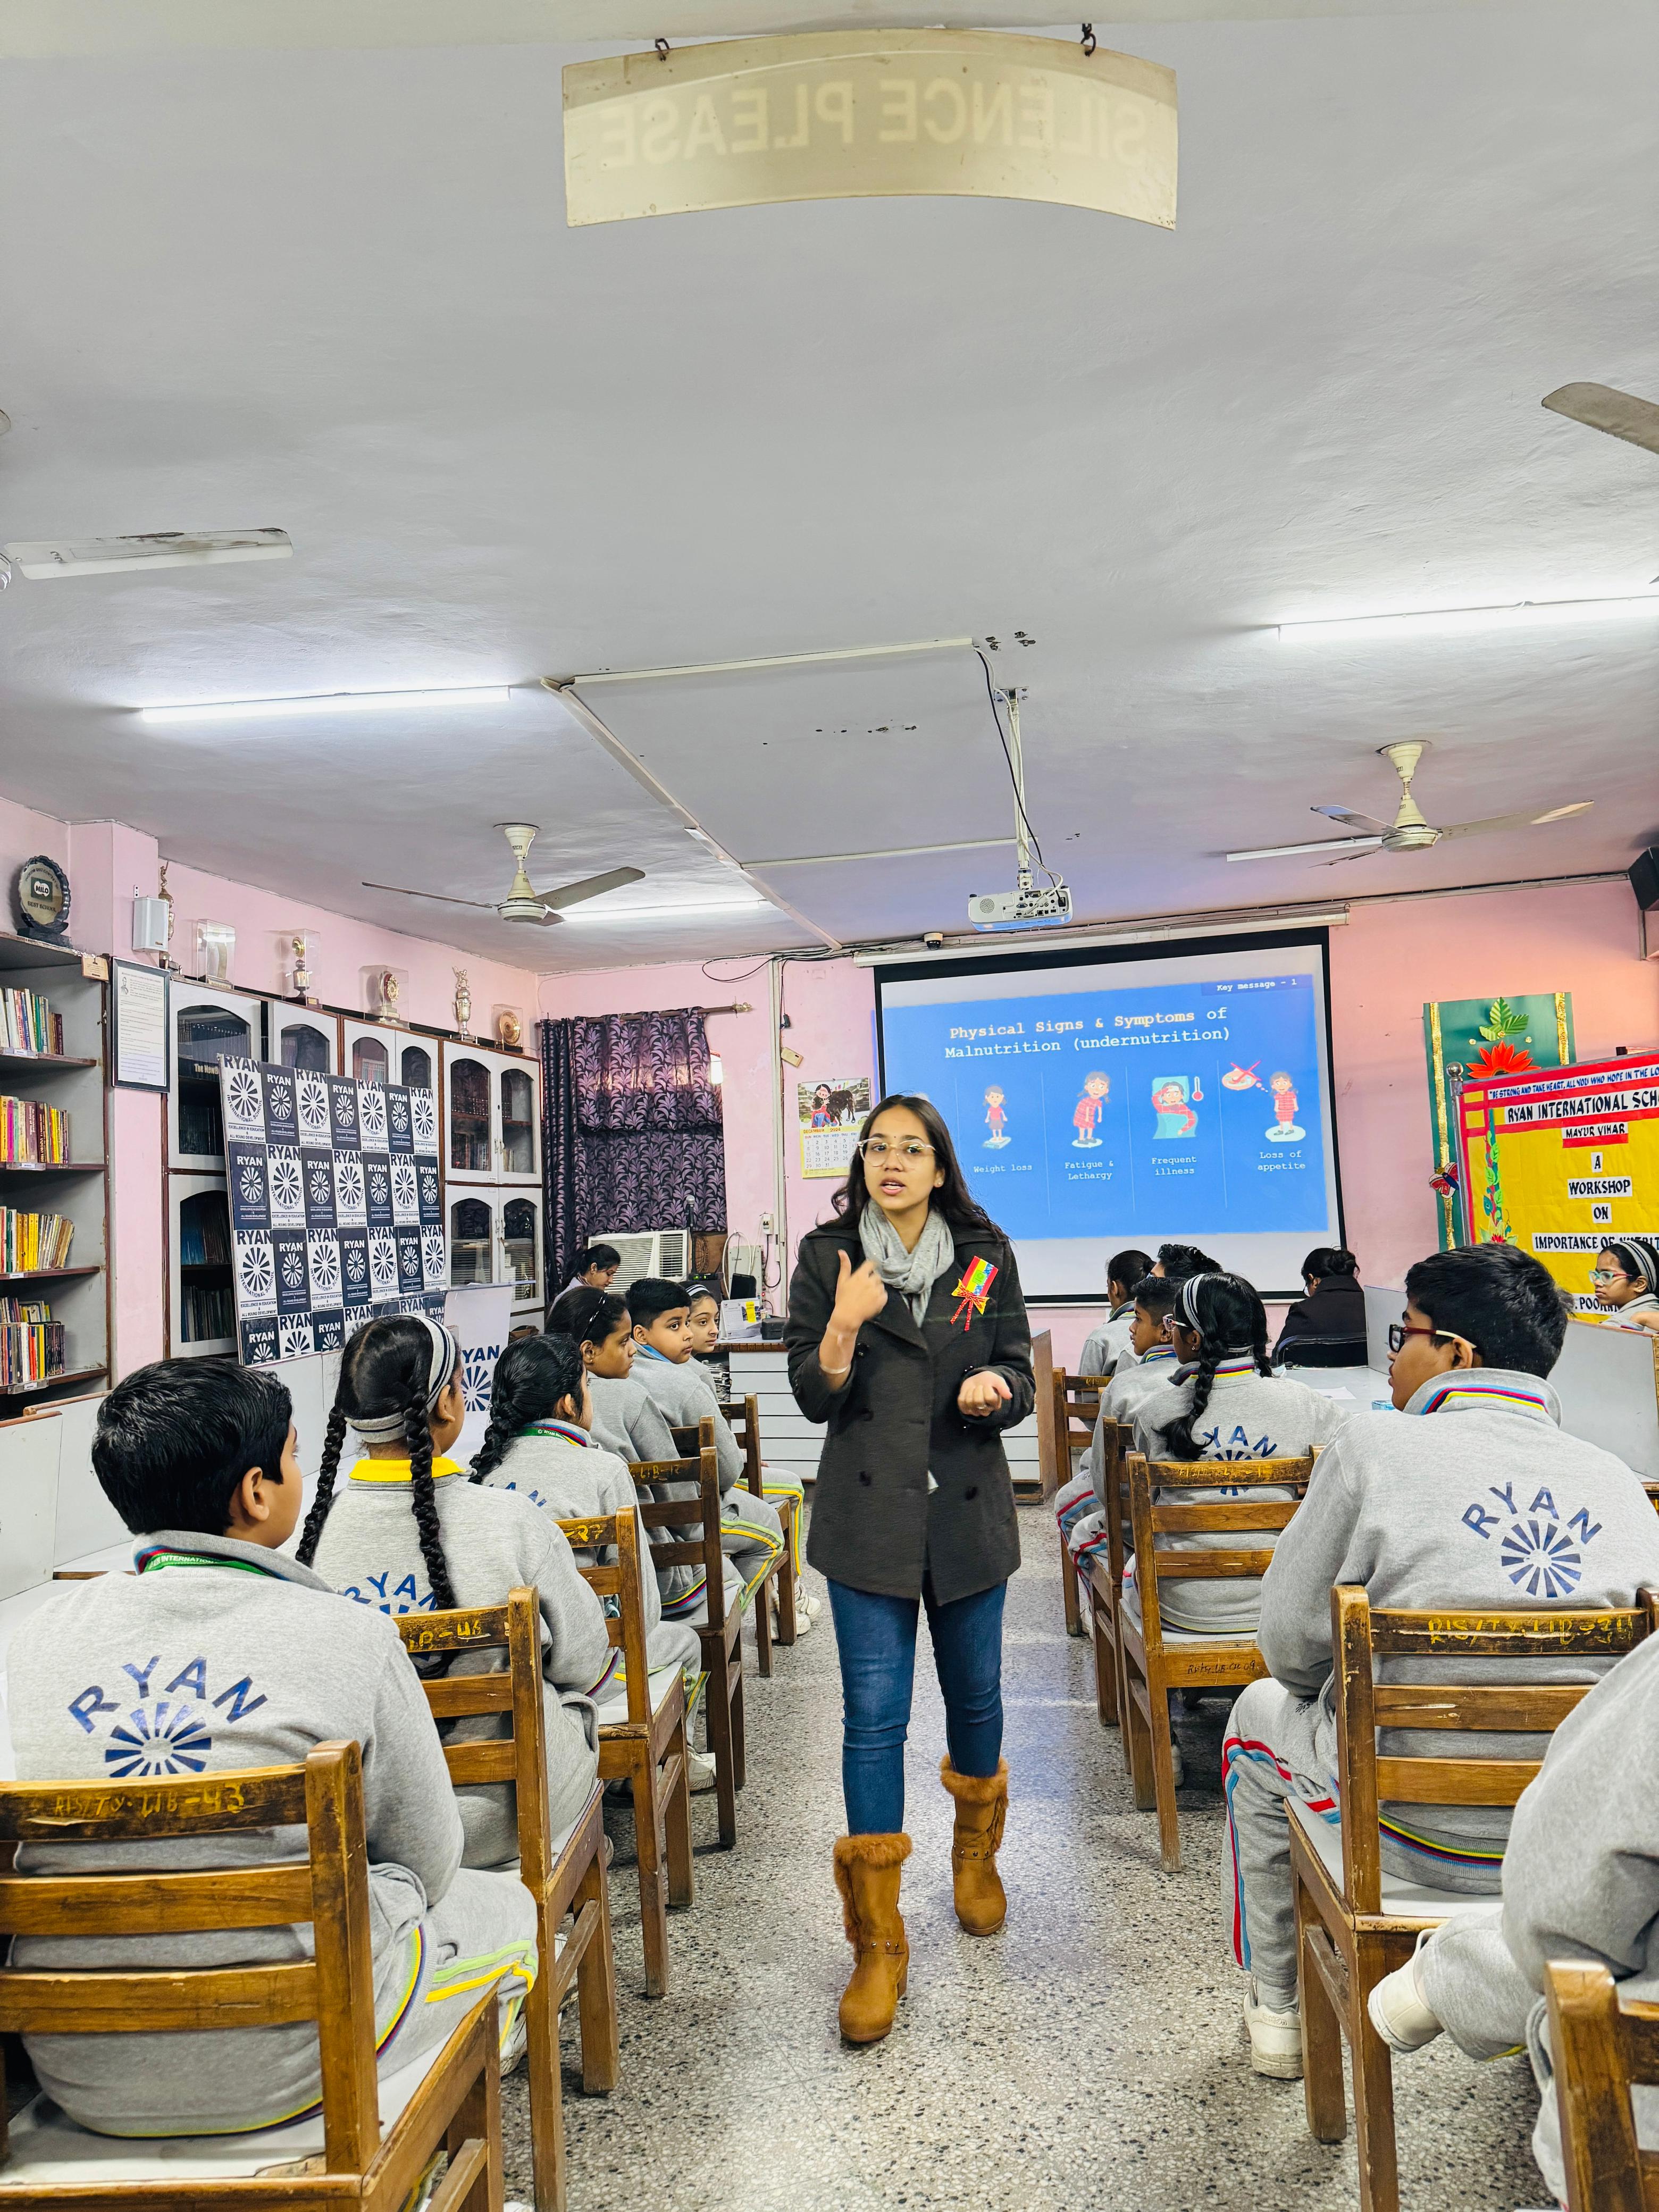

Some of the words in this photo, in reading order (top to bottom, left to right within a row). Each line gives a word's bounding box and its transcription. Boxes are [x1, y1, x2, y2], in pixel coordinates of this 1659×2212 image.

[36, 885, 48, 894] MILO
[1237, 981, 1276, 990] message
[950, 1023, 1025, 1040] Physical
[1036, 1020, 1084, 1034] Signs
[1095, 1018, 1104, 1028] &
[1115, 1012, 1195, 1029] Symptoms
[1206, 1007, 1227, 1020] of
[945, 1041, 1061, 1058] Malnutrition
[1074, 1027, 1229, 1051] (undernutrition)
[194, 1063, 204, 1073] The
[267, 1074, 291, 1086] RYAN
[1499, 1087, 1520, 1097] STRONG
[1532, 1083, 1545, 1093] TAKE
[1566, 1078, 1576, 1088] ALL
[1577, 1078, 1589, 1087] YOU
[1590, 1075, 1605, 1084] WHO
[1607, 1073, 1623, 1083] HOPE
[1625, 1070, 1632, 1079] IN
[1634, 1068, 1648, 1078] THE
[333, 1084, 354, 1095] RYAN
[389, 1093, 407, 1102] RYAN
[1508, 1105, 1532, 1122] RYAN
[1538, 1094, 1628, 1119] INTERNATIONAL
[1632, 1090, 1659, 1108] SCH
[1566, 1126, 1594, 1138] MAYUR
[1598, 1124, 1625, 1135] VIHAR
[267, 1145, 301, 1160] RYAN
[334, 1150, 363, 1164] RYAN
[237, 1156, 263, 1166] RYAN
[307, 1161, 330, 1170] RYAN
[391, 1154, 416, 1166] RYAN
[1065, 1161, 1103, 1170] Fatigue
[1151, 1156, 1197, 1166] Frequent
[1594, 1155, 1601, 1169] A
[367, 1164, 387, 1172] RYAN
[420, 1166, 437, 1175] RYAN
[974, 1165, 1006, 1174] Weight
[1258, 1162, 1306, 1171] appetite
[1068, 1172, 1112, 1180] Lethargy
[1569, 1179, 1630, 1195] WORKSHOP
[1594, 1206, 1608, 1219] ON
[237, 1230, 273, 1245] RYAN
[308, 1229, 339, 1243] RYAN
[369, 1227, 396, 1240] RYAN
[279, 1242, 303, 1252] RYAN
[344, 1240, 365, 1249] RYAN
[400, 1237, 418, 1246] RYAN
[1535, 1236, 1598, 1249] IMPORTANCE
[239, 1272, 265, 1297] INTERNATIONAL
[280, 1312, 313, 1330] RYAN
[319, 1322, 341, 1334] RYAN
[249, 1331, 275, 1343] RYAN
[462, 1345, 500, 1363] YAN
[1200, 1426, 1277, 1457] YAN
[1462, 1482, 1602, 1544] RYAN
[68, 1655, 267, 1733] RYAN
